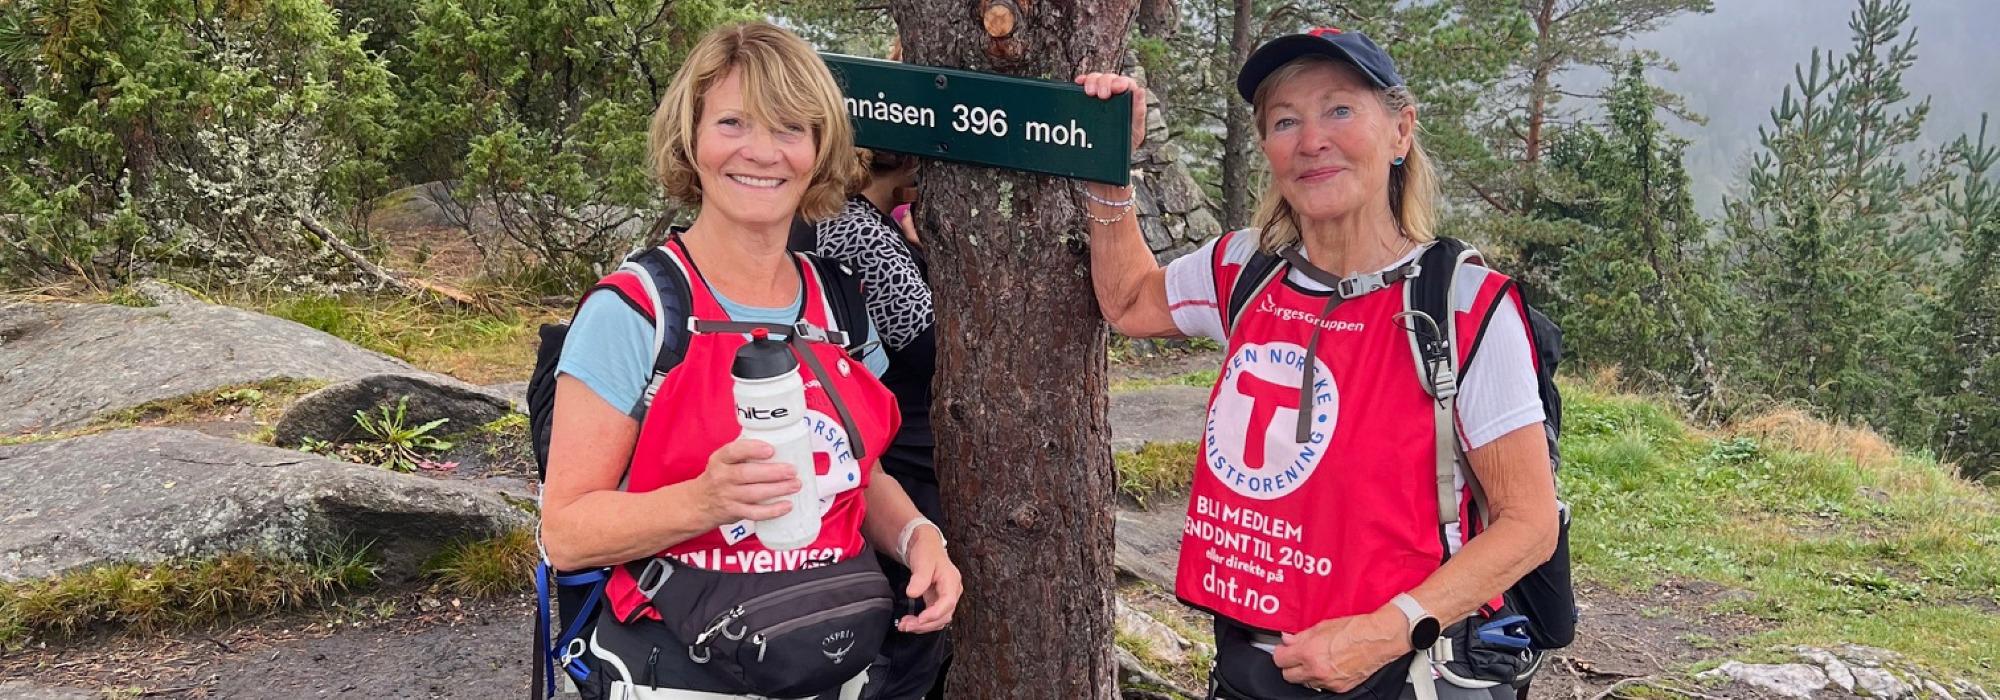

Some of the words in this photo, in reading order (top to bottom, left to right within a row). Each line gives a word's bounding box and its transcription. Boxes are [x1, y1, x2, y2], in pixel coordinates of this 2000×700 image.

[951, 104, 1009, 138] 396
[1025, 119, 1094, 149] moh.
[1274, 306, 1365, 332] rgesGruppen
[1196, 495, 1219, 519] BLI
[1222, 503, 1303, 542] MEDLEM
[1214, 527, 1251, 553] DNT
[1252, 537, 1274, 562] TIL
[1278, 547, 1332, 576] 2030
[1226, 554, 1265, 578] direkte
[1266, 568, 1284, 583] på
[1202, 564, 1280, 615] dnt.no
